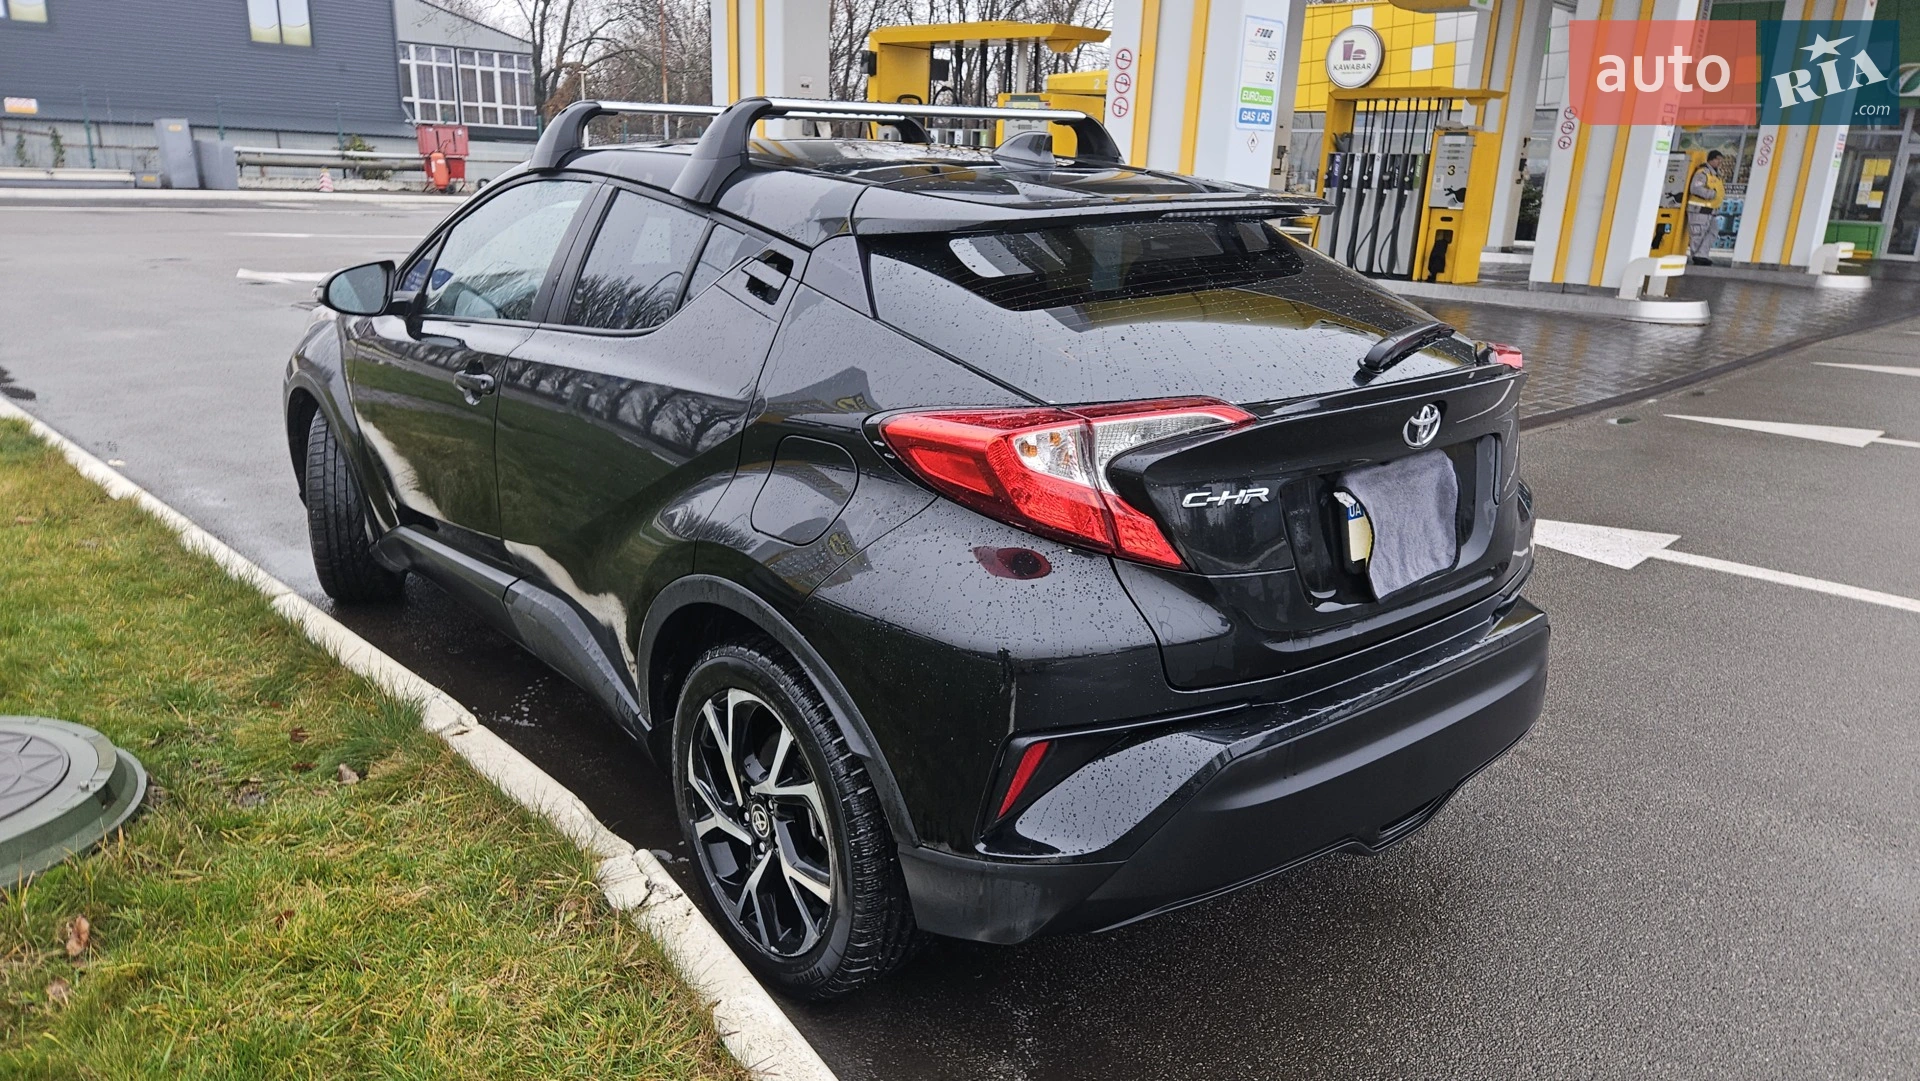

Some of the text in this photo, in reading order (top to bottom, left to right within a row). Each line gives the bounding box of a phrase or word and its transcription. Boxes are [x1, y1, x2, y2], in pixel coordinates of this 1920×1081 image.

[1255, 28, 1274, 38] F100
[1267, 50, 1277, 61] 95
[1333, 63, 1372, 71] KAWABAR
[1265, 71, 1275, 82] 92
[1241, 110, 1271, 123] GAS LPG
[1447, 164, 1456, 176] 3
[1668, 174, 1675, 184] 5
[1182, 487, 1270, 508] C-HR
[1349, 502, 1362, 518] UA
